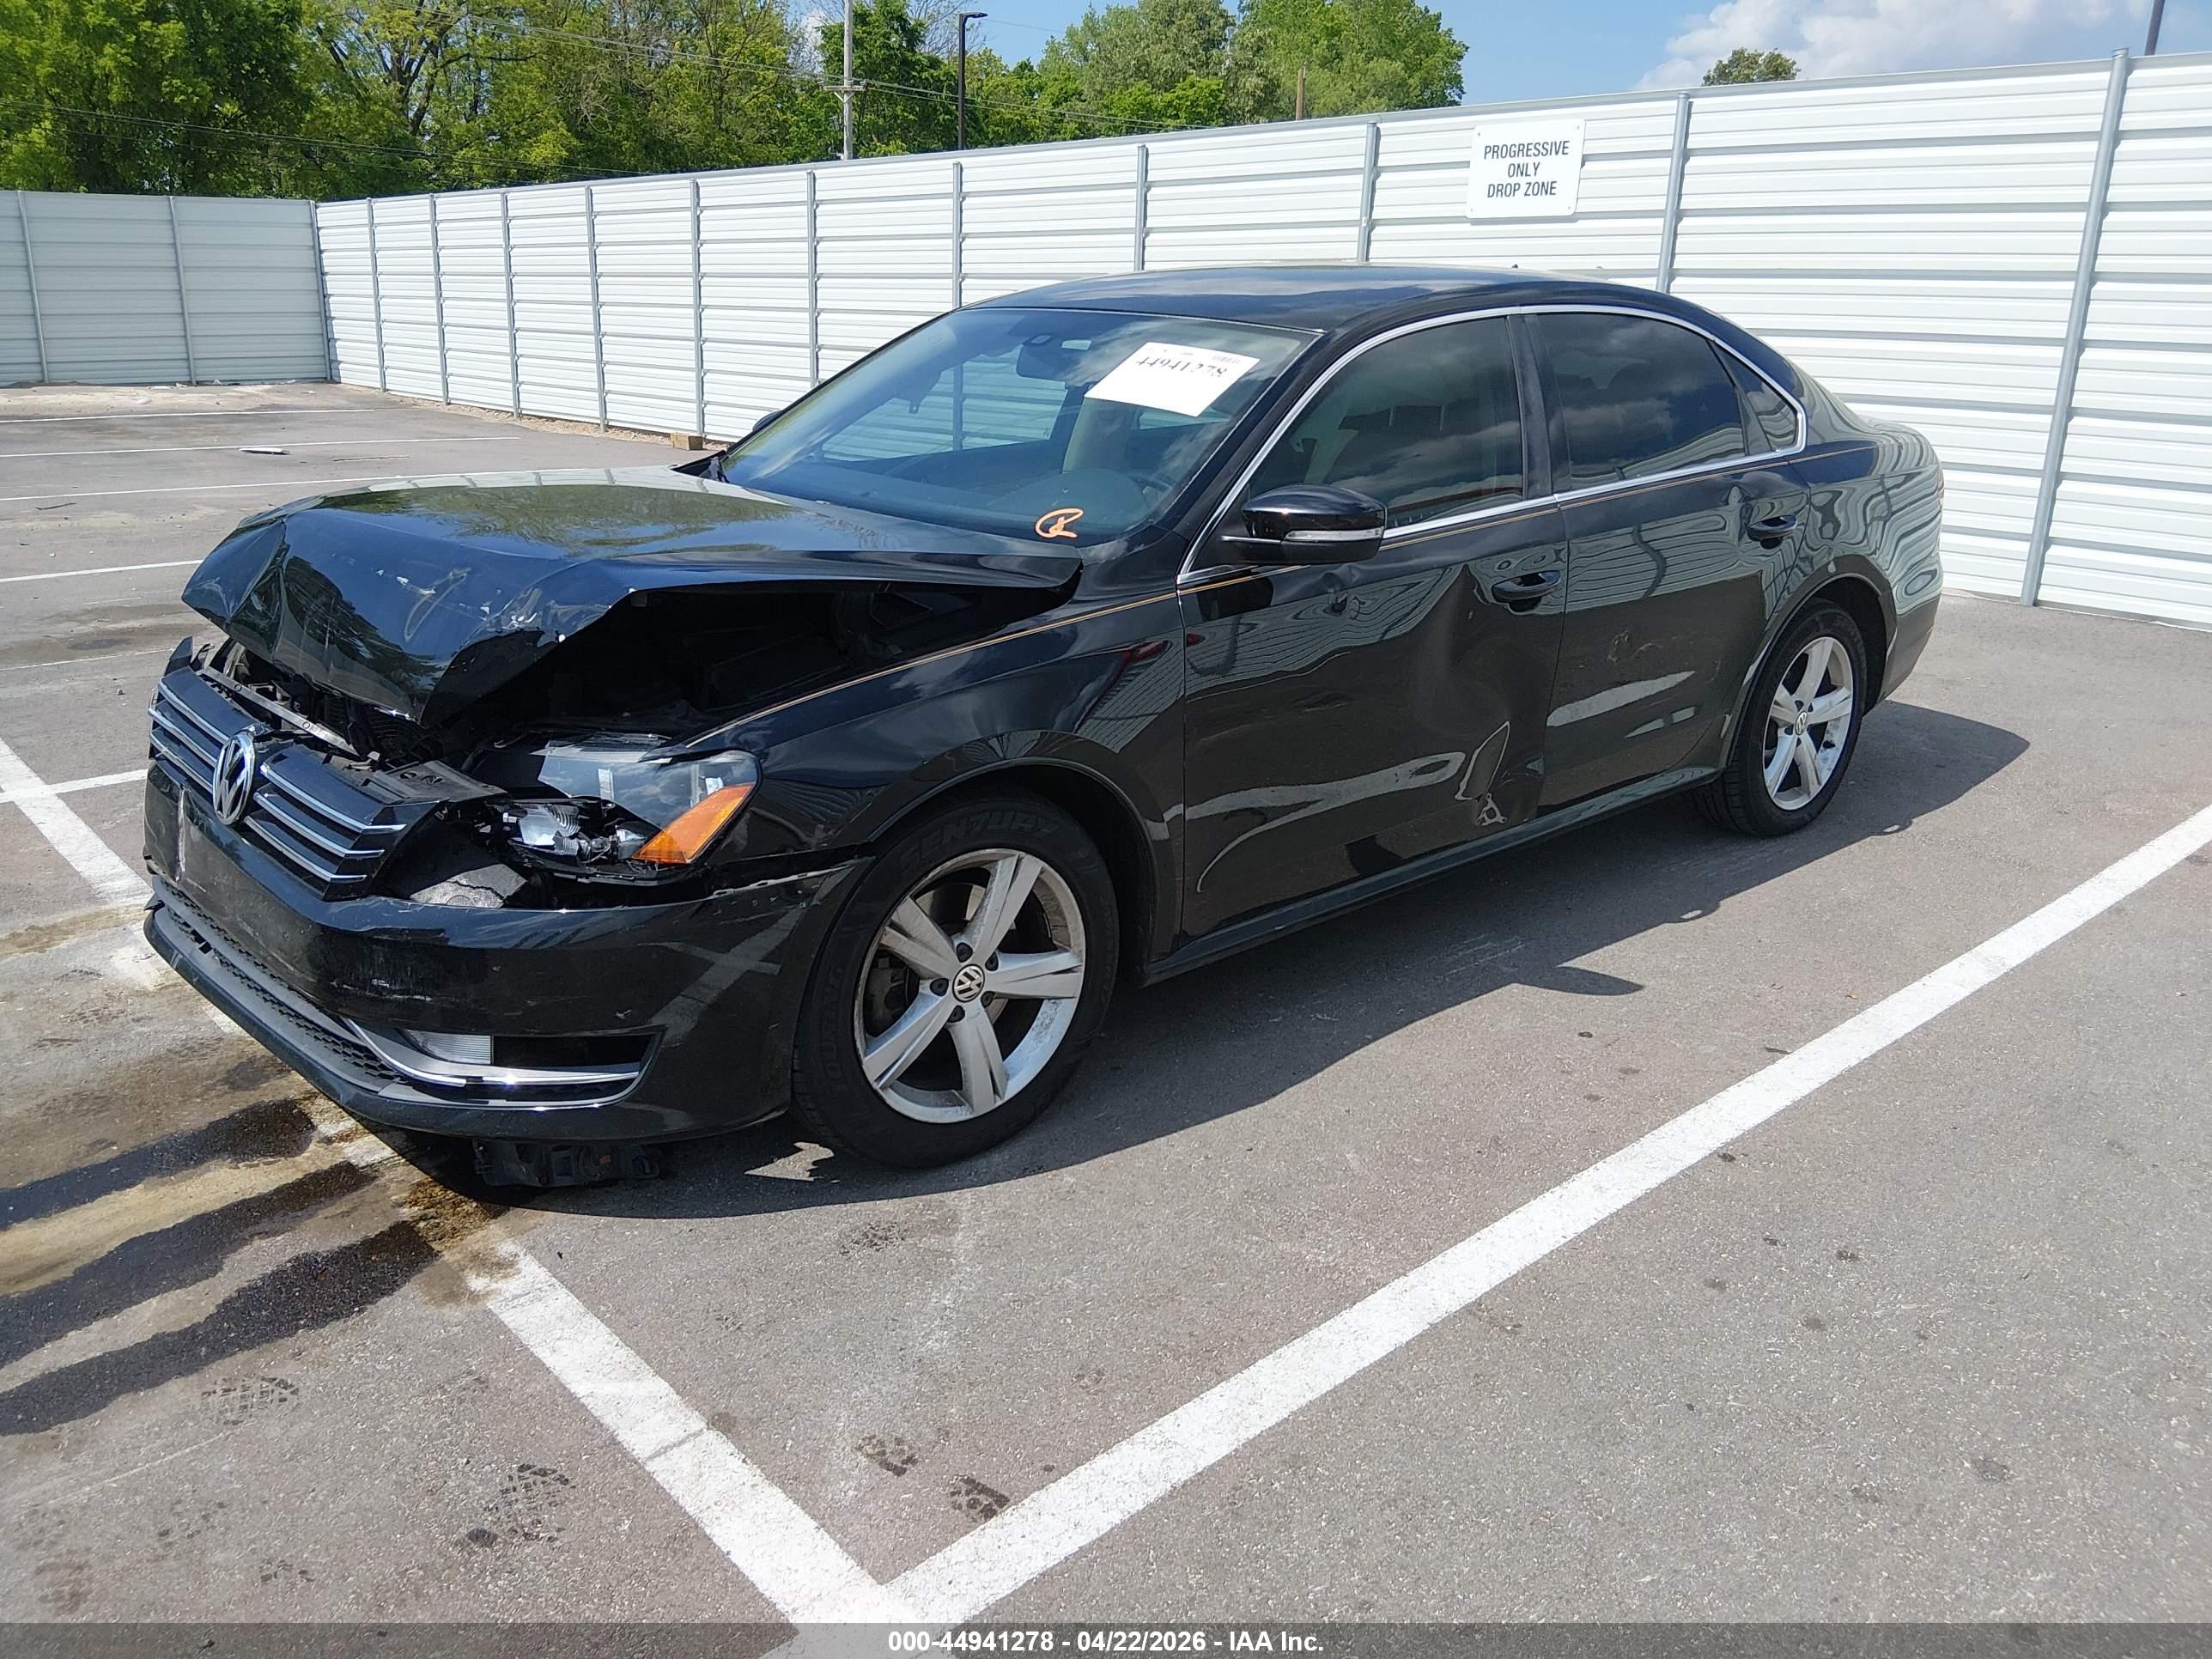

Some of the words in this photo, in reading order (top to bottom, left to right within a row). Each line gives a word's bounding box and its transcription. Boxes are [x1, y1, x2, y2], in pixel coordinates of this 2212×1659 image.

[1484, 140, 1570, 160] PROGRESSIVE
[1508, 161, 1540, 178] ONLY
[1487, 182, 1521, 198] DROP
[1523, 180, 1557, 197] ZONE
